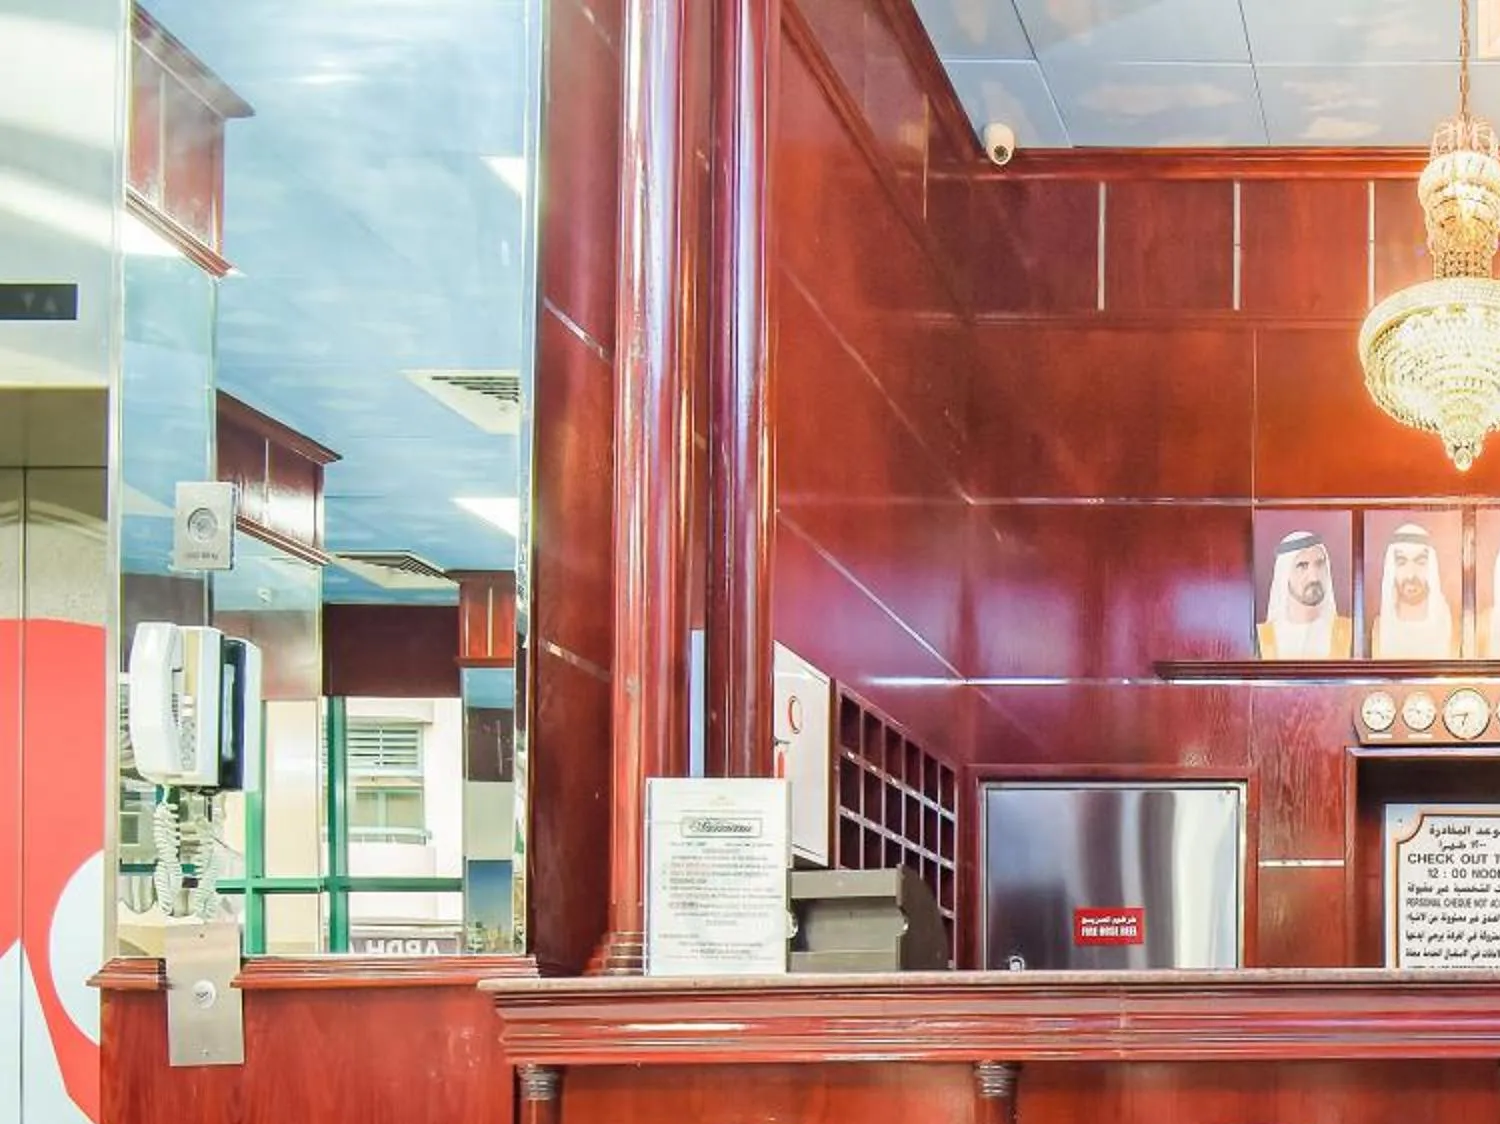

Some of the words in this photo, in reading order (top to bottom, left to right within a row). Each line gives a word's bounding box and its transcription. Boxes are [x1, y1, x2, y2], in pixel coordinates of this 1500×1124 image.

[1429, 824, 1471, 838] المغادرة
[1407, 853, 1454, 865] CHECK
[1460, 853, 1489, 865] OUT
[1428, 867, 1440, 879] 12
[1451, 867, 1467, 879] 00
[1406, 898, 1441, 909] PERSONAL
[1443, 898, 1472, 909] CHEQUE
[1473, 898, 1488, 909] NOT
